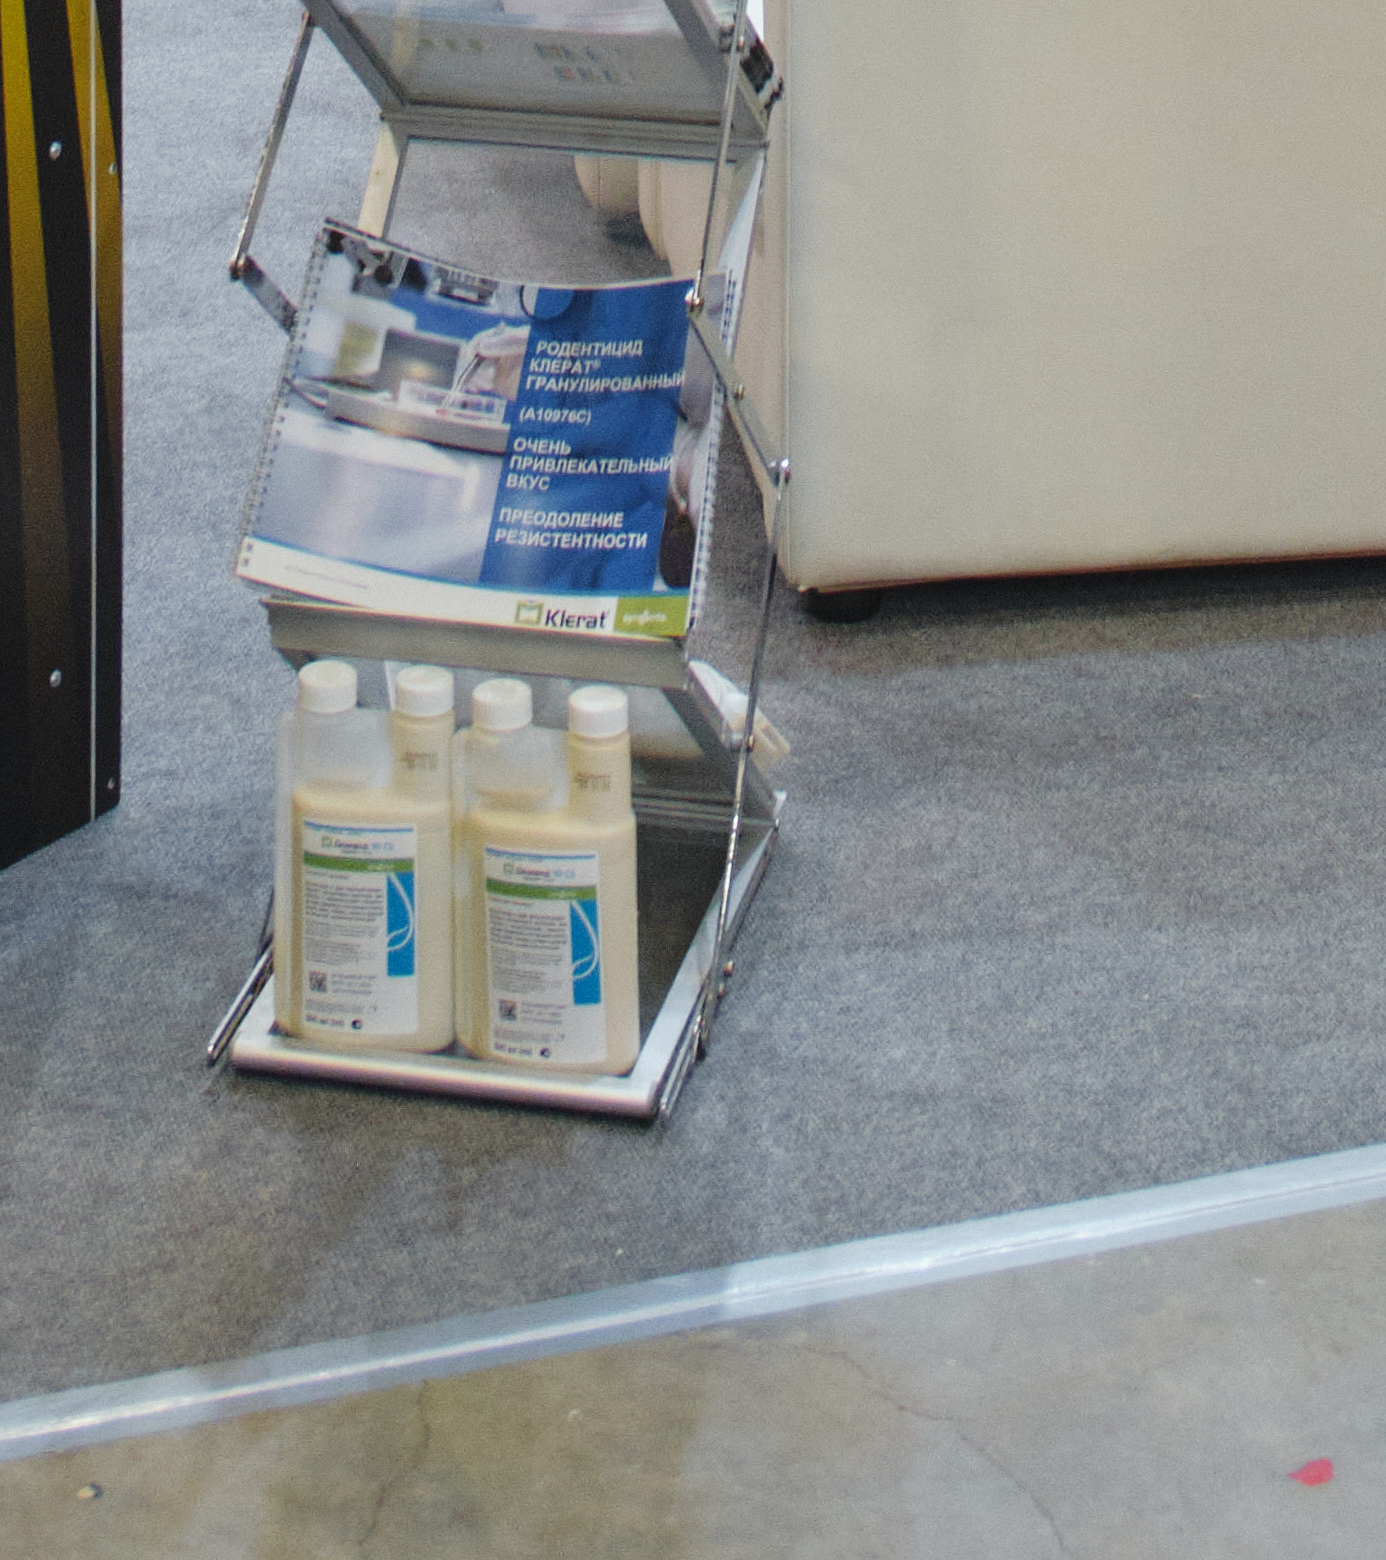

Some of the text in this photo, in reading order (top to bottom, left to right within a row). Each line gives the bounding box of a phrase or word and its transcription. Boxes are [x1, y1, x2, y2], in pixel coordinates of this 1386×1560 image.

[536, 339, 643, 359] РОДЕНТИЦИД
[525, 371, 686, 393] ГРАНУЛИРОВАННЫЙ
[514, 437, 571, 455] ОЧЕНЬ
[509, 453, 674, 474] ПРИВЛЕКАТЕЛЬНЫЙ
[506, 473, 550, 490] ВКУС
[499, 508, 625, 528] ПРЕОДОЛЕНИЕ
[495, 528, 648, 550] РЕЗИСТЕНТНОСТИ
[544, 609, 607, 630] Klerat
